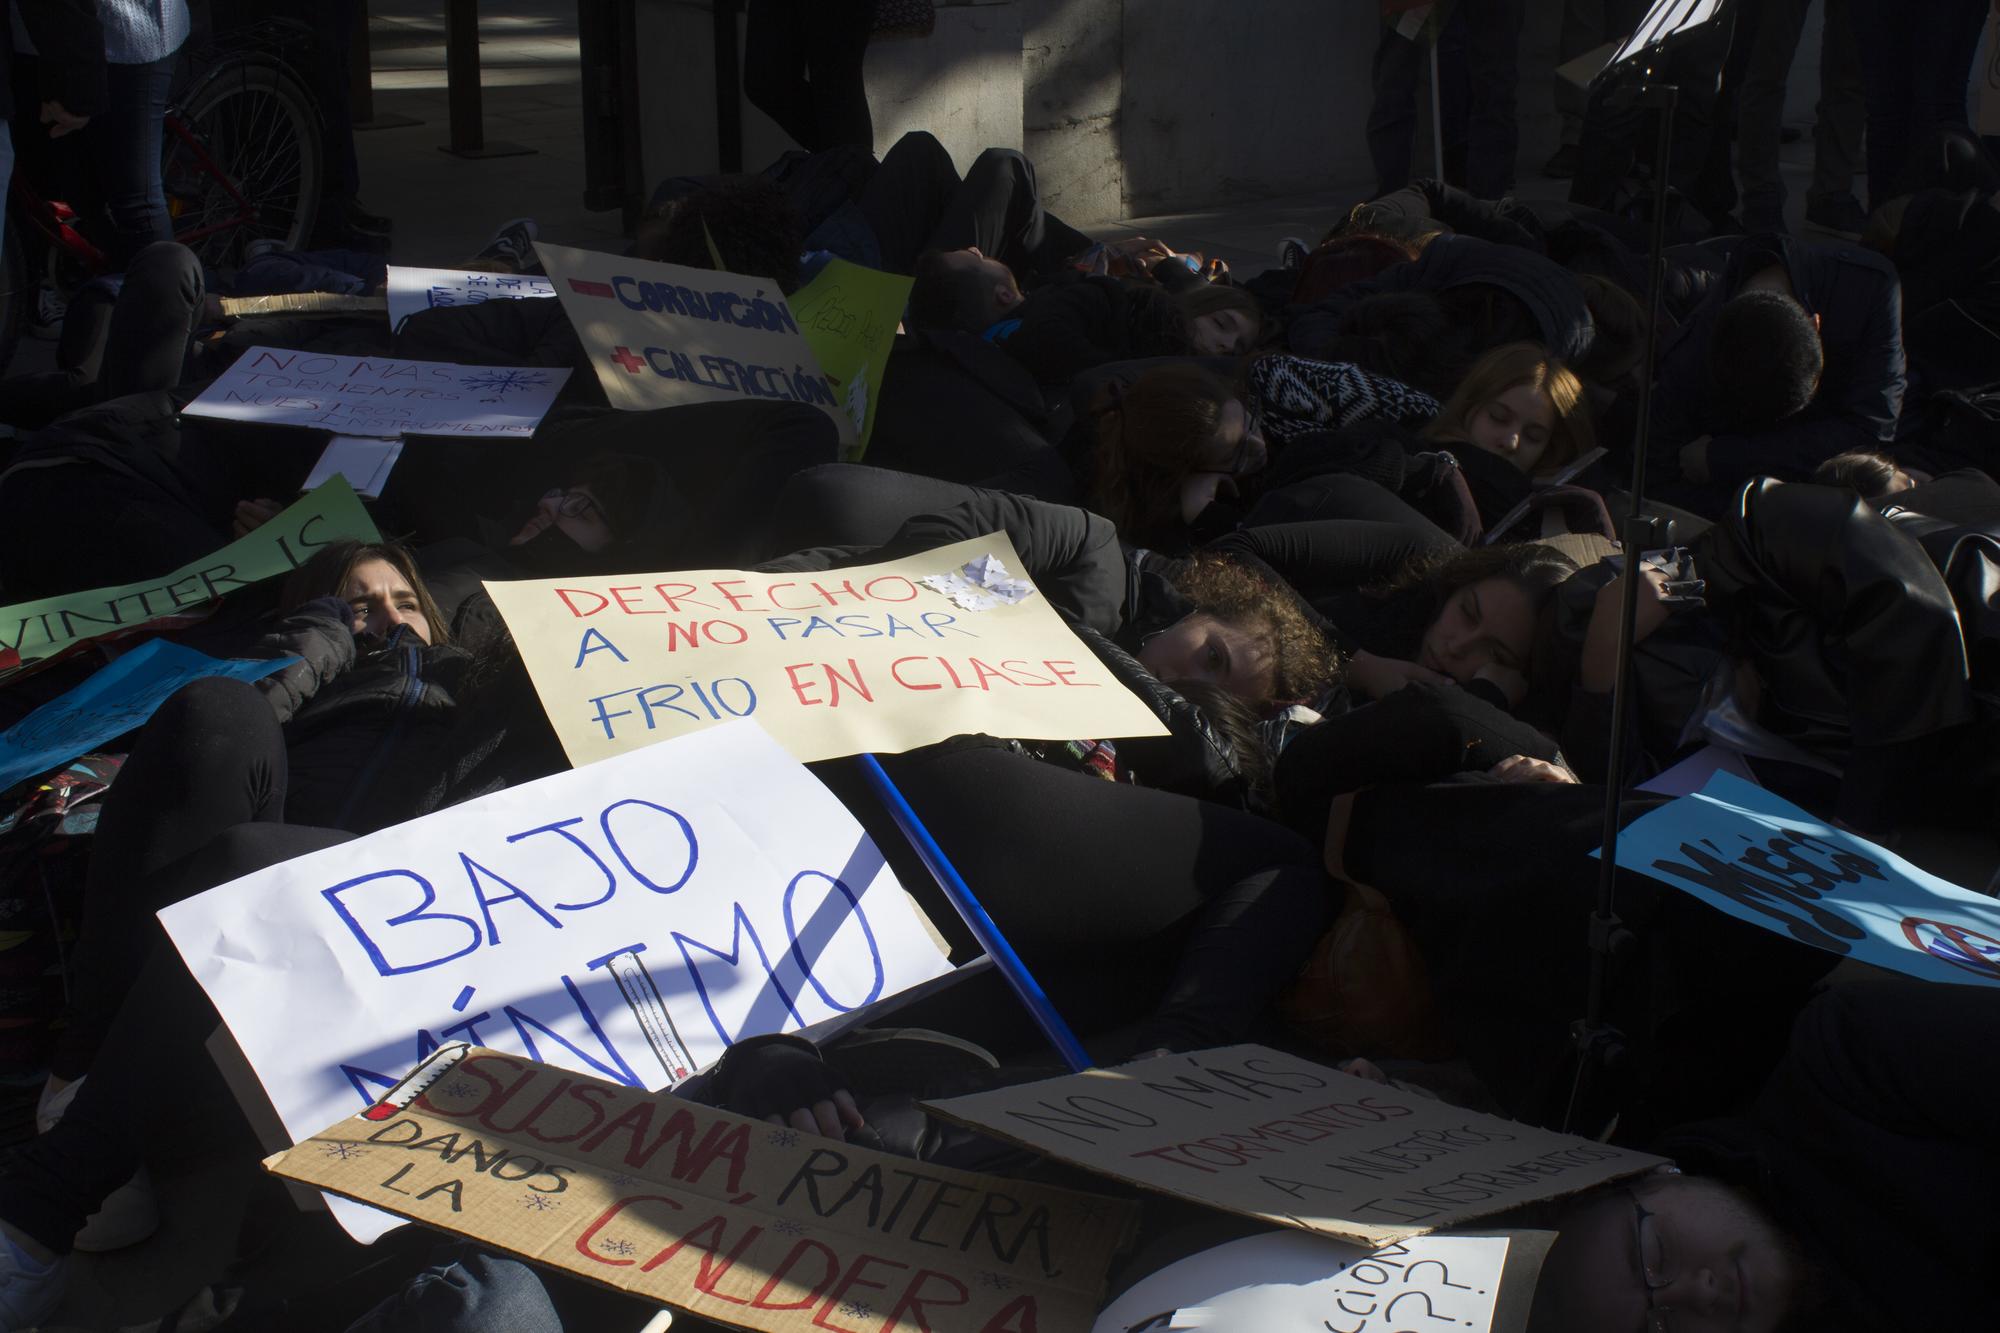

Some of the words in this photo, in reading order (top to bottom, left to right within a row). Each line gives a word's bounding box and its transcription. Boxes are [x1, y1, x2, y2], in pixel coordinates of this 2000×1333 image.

[239, 371, 461, 400] TORMENTOS
[251, 352, 338, 375] NO
[224, 390, 416, 417] NUESTROS
[554, 575, 919, 618] DERECHO
[574, 627, 630, 669] A
[667, 619, 749, 653] NO
[766, 611, 980, 641] PASAR
[785, 657, 875, 708] EN
[891, 655, 1101, 691] CLASE
[320, 798, 699, 977] BAJO
[1005, 1095, 1157, 1145] NO
[1142, 1057, 1327, 1109] MÁS
[367, 1118, 577, 1194] DANOS
[1130, 1096, 1414, 1173] TORMENTOS
[381, 1162, 464, 1213] LA
[1259, 1175, 1343, 1200] A
[1325, 1125, 1517, 1180] NUESTROS
